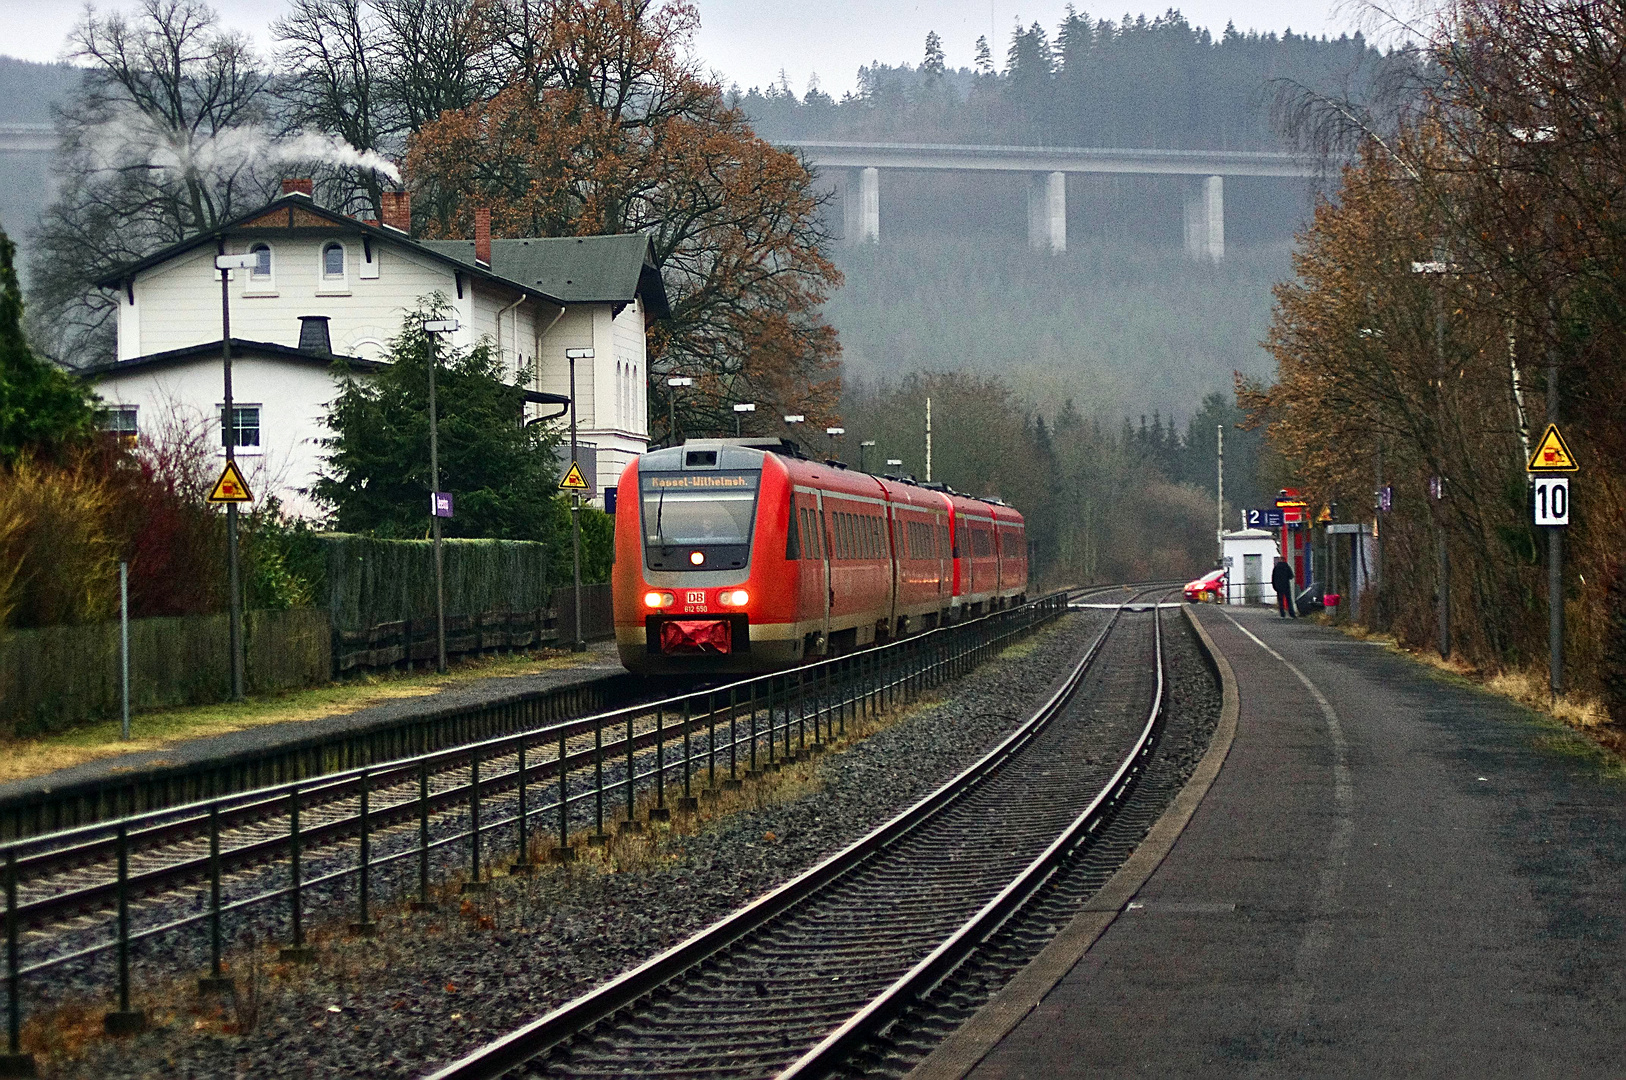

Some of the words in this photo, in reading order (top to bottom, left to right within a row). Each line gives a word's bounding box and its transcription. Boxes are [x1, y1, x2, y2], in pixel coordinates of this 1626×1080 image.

[1537, 484, 1567, 519] 10
[1249, 509, 1260, 524] 2
[688, 593, 704, 603] DB
